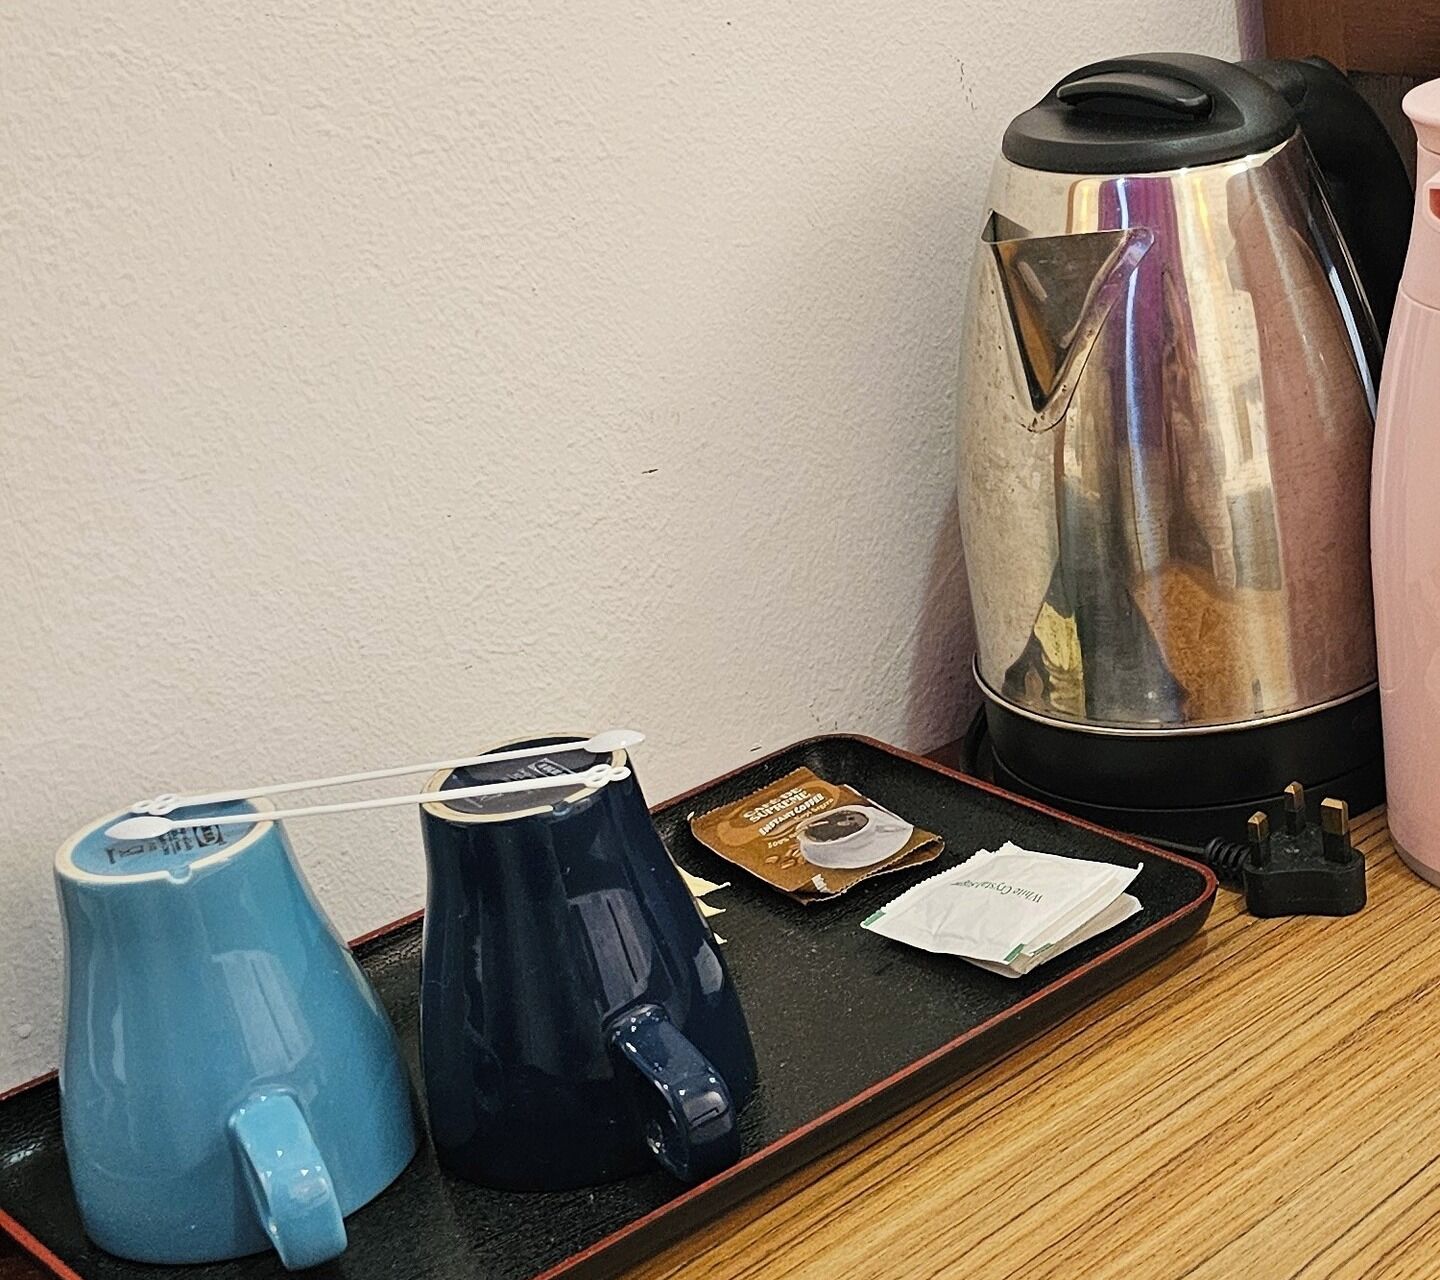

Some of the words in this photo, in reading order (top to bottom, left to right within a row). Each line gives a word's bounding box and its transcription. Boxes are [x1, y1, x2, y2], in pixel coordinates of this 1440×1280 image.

[749, 790, 812, 823] SUPREME
[758, 810, 796, 836] INSTANT
[793, 793, 825, 815] COFFEE
[1013, 887, 1044, 903] White
